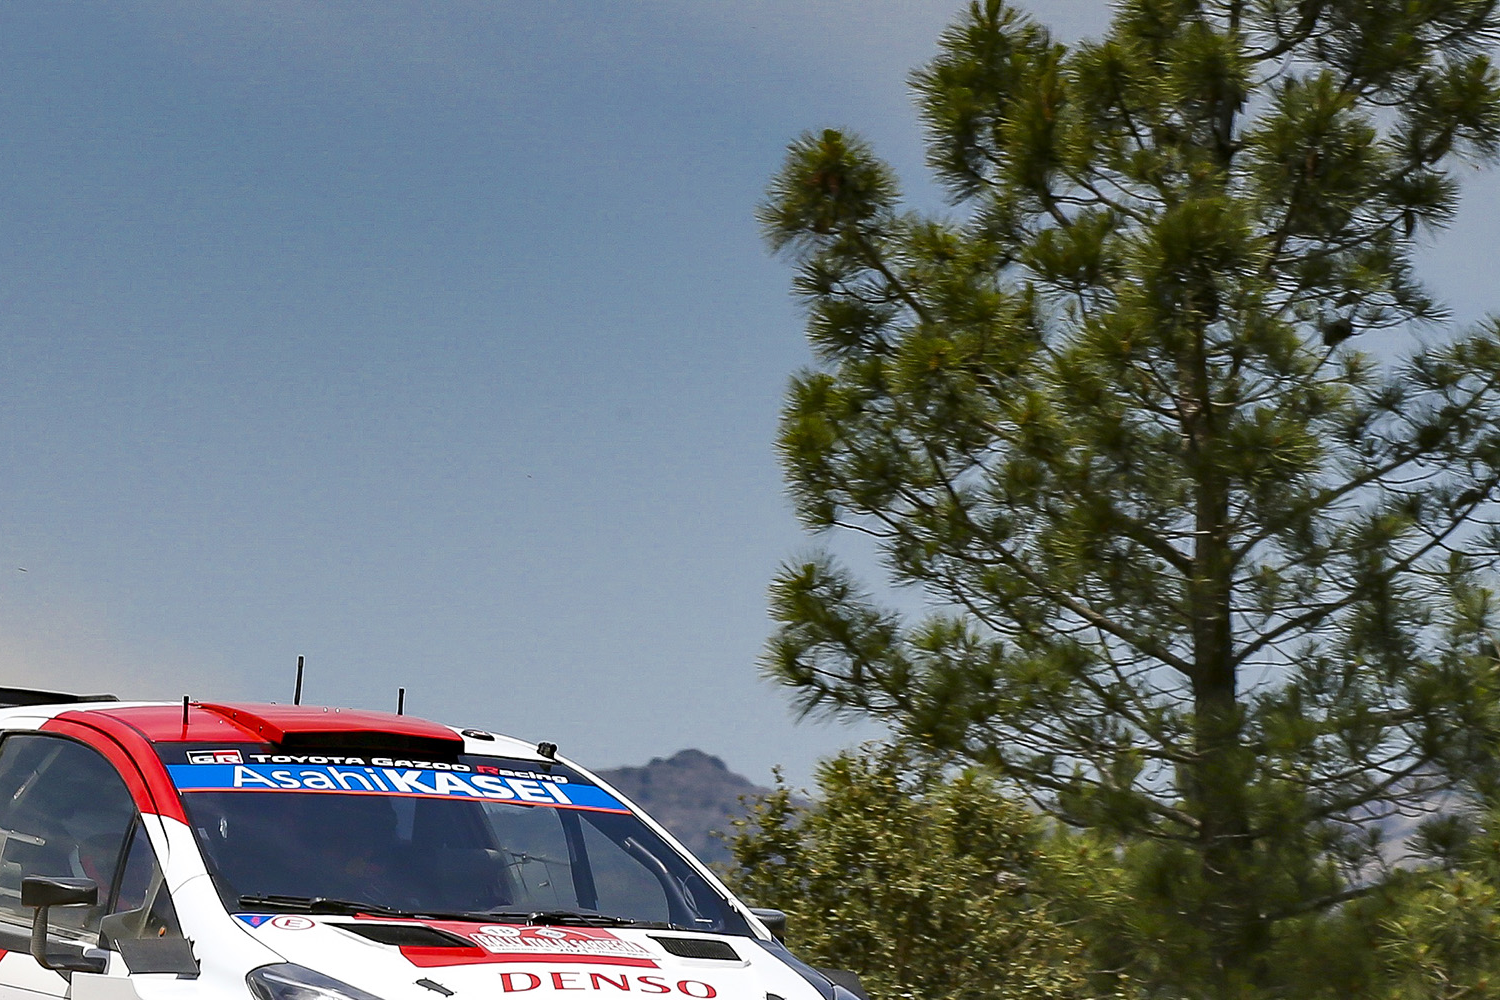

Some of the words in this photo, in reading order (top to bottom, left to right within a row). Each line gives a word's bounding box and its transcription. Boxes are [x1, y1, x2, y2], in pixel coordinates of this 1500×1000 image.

[249, 754, 365, 765] TOYOTA
[370, 757, 471, 772] GAZOO
[476, 765, 569, 784] Racing
[499, 972, 717, 998] DENSO
